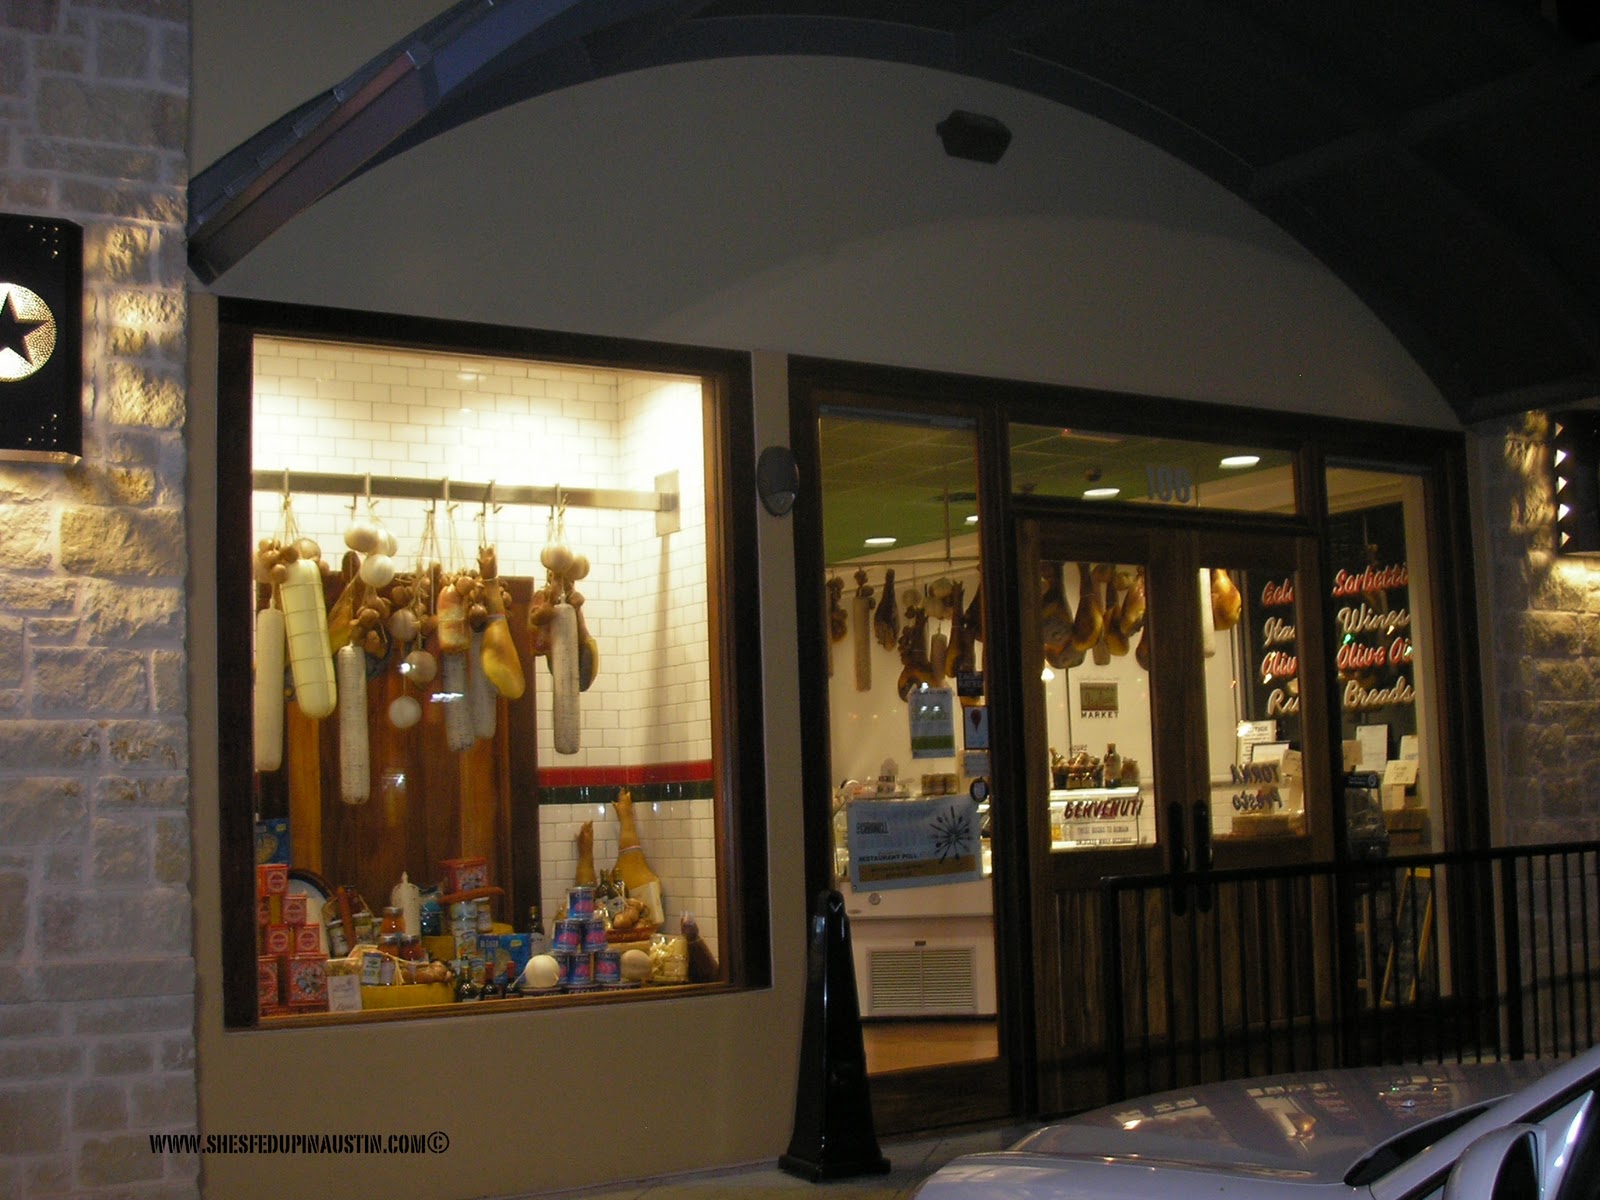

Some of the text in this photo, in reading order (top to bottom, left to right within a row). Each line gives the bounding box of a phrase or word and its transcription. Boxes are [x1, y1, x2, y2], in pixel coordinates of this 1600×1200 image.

[1264, 602, 1411, 647] Ita Wines
[1261, 637, 1413, 677] Oliv Olive Oi
[1081, 711, 1119, 719] MARKET
[1267, 676, 1415, 715] Ru Breads
[1064, 797, 1144, 819] BENVENUTI
